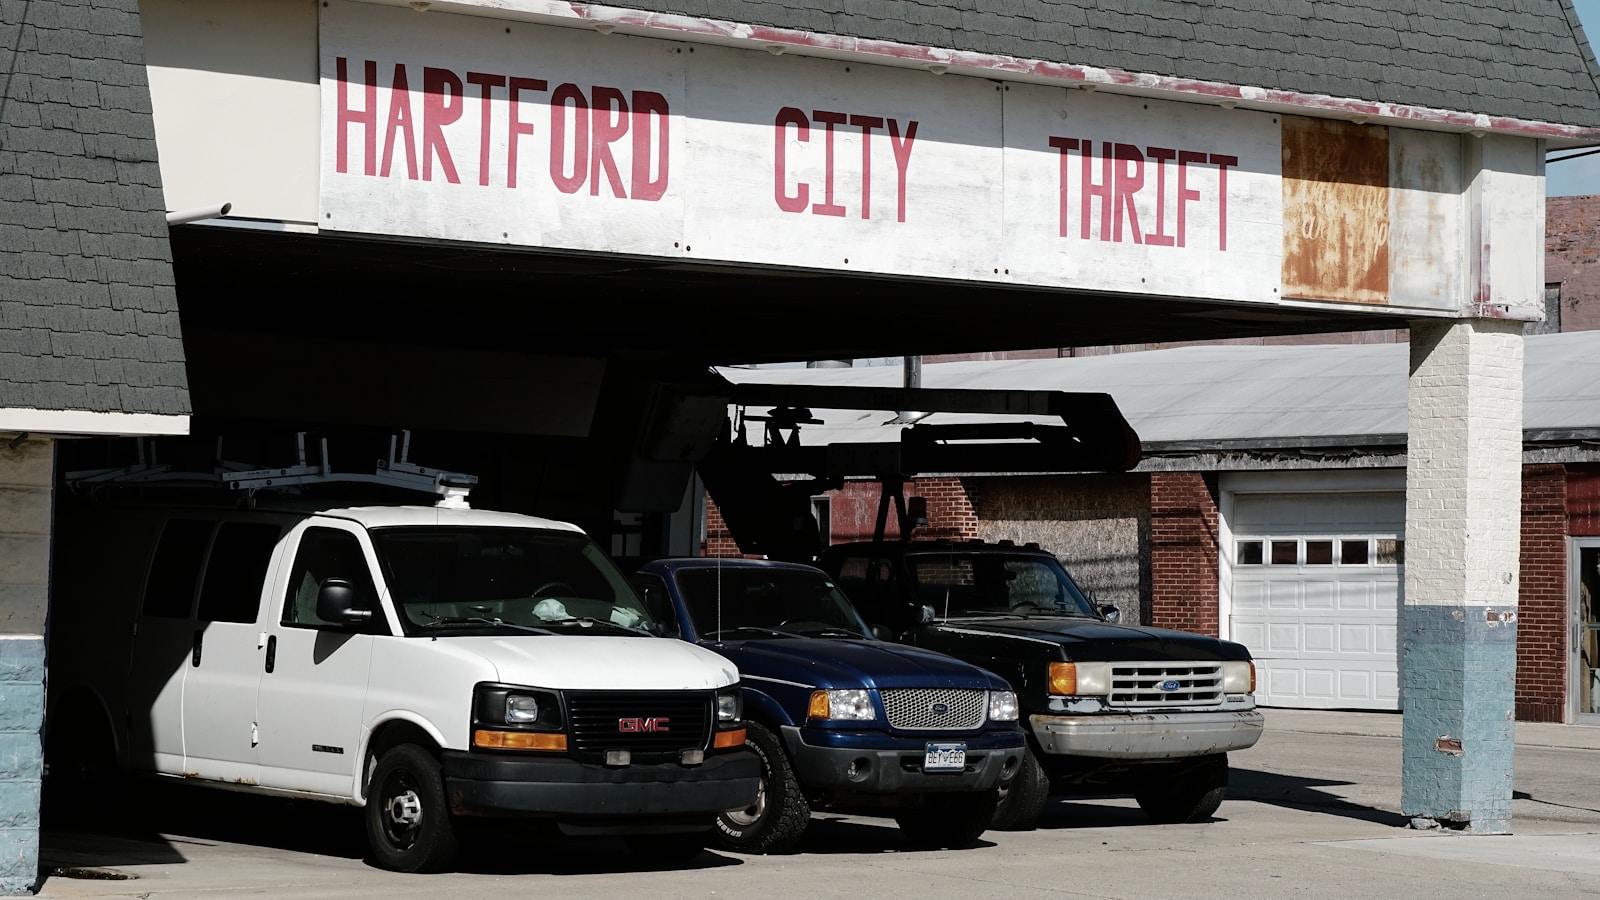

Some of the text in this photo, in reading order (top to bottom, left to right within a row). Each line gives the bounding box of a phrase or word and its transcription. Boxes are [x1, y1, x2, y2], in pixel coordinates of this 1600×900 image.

[336, 57, 670, 201] HARTFORD
[775, 106, 919, 223] CITY
[1049, 136, 1238, 252] THRIFT
[619, 717, 669, 732] GMC
